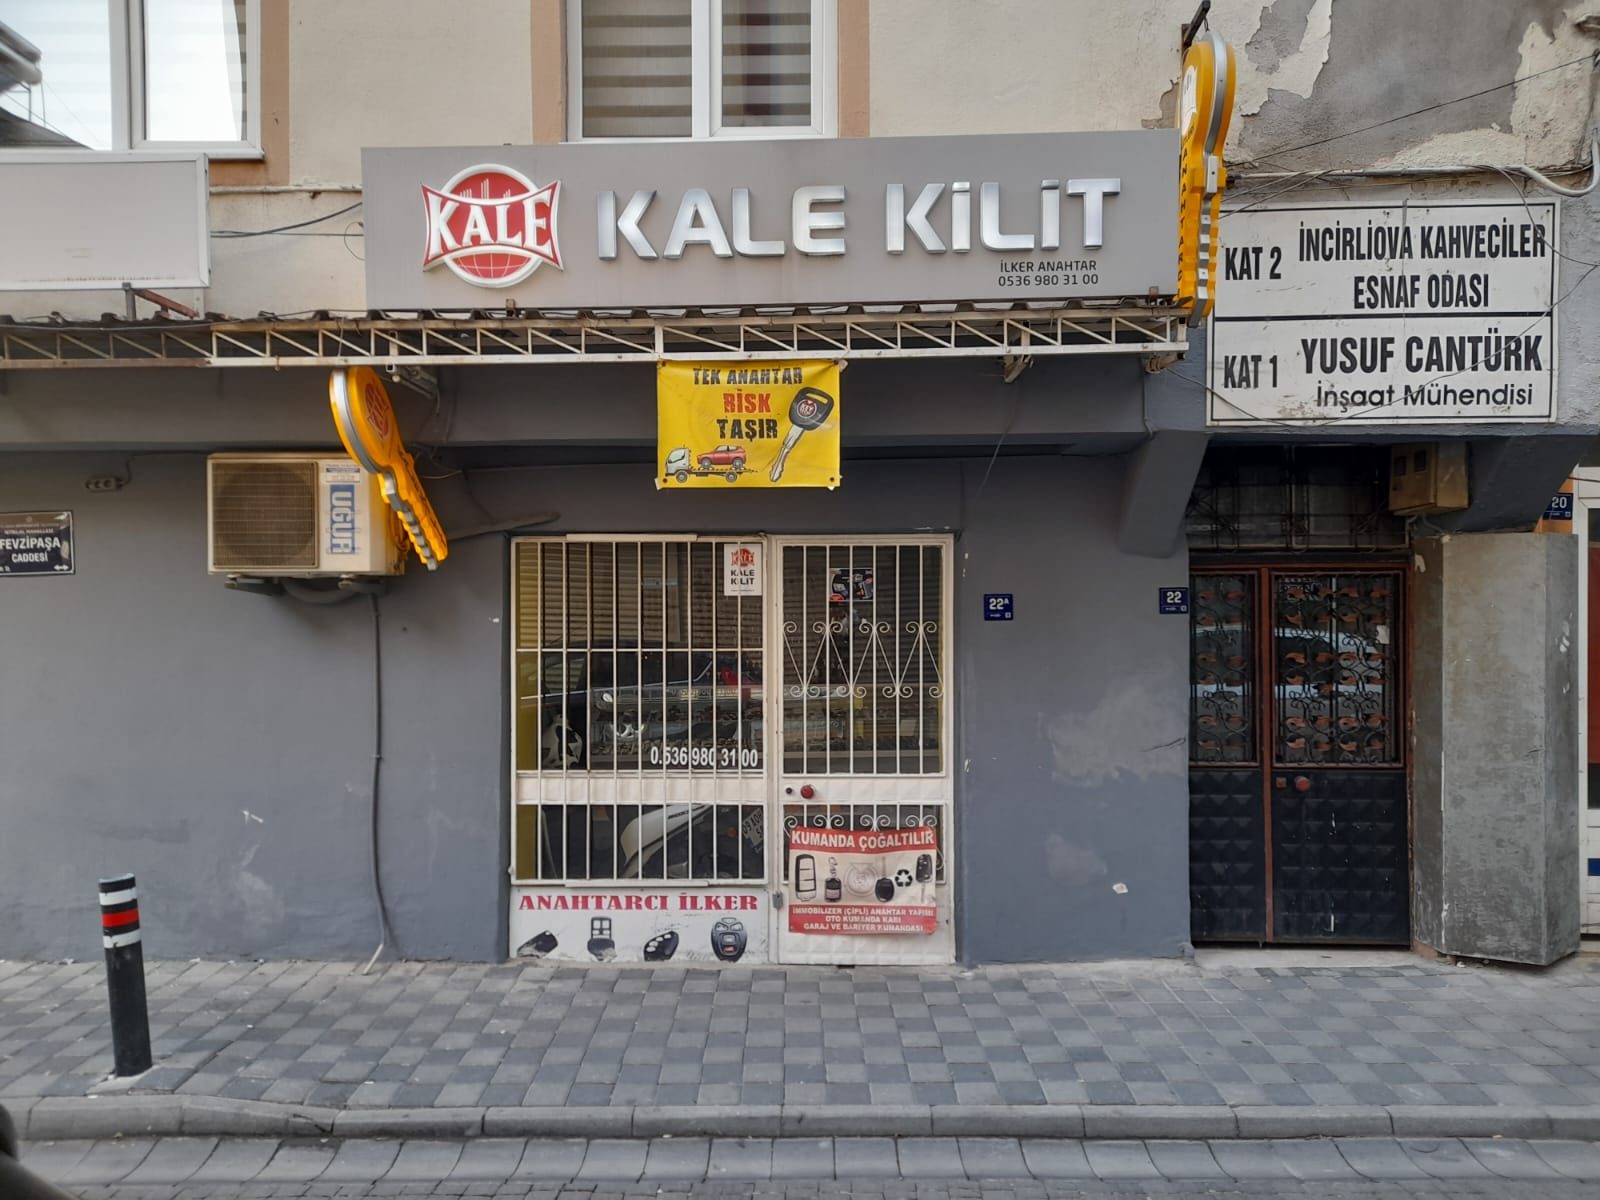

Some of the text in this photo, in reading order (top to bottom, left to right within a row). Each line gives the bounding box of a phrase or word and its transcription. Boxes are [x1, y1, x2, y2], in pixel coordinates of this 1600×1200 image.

[427, 191, 552, 260] KALE
[597, 178, 1121, 259] KALE KİLİT
[1299, 217, 1547, 262] İNCİRLİOVA KAHVECİLER
[1000, 259, 1098, 273] İLKER ANAHTAR
[1225, 246, 1282, 281] KAT 2
[998, 273, 1099, 287] 0536 980 31 00
[1353, 273, 1489, 309] ESNAF ODASI
[1300, 328, 1543, 374] YUSUF CANTÜRK
[692, 366, 803, 385] TEK ANAHTAR
[1224, 355, 1279, 389] KAT 1
[723, 389, 771, 414] RİSK
[1317, 380, 1533, 413] İnşaat Mühendisi
[716, 418, 779, 442] TAŞIR
[1551, 496, 1568, 509] 20
[0, 536, 61, 551] FEVZİPAŞA
[11, 551, 48, 563] CADDESİ
[1166, 591, 1182, 604] 22
[650, 746, 758, 767] 0.536 980 31 00
[791, 829, 935, 851] KUMANDA ÇOĞALTILIR
[518, 892, 758, 911] ANAHTARCI İLKER
[870, 908, 907, 916] ANAHTAR
[842, 915, 880, 923] KUMANDA
